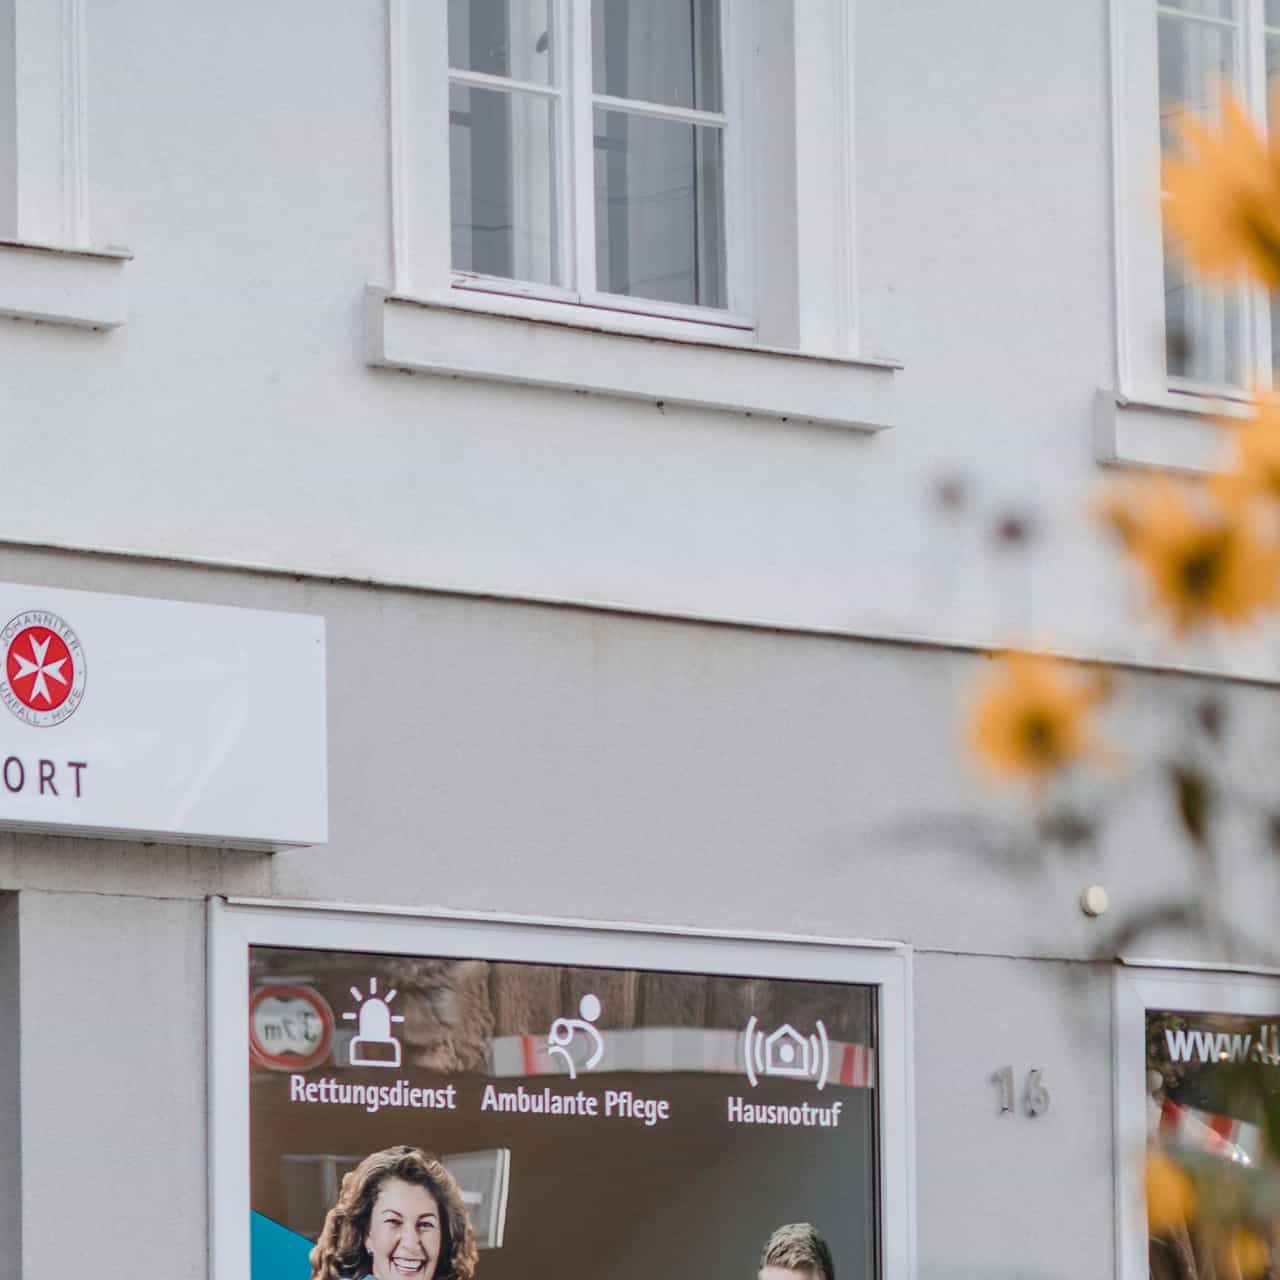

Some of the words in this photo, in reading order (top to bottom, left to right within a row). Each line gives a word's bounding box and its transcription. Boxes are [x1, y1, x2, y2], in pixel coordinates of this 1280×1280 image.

[3, 755, 88, 798] ORT
[290, 1073, 457, 1112] Rettungsdienst
[480, 1087, 599, 1118] Ambulante
[604, 1091, 670, 1126] Pflege
[990, 1064, 1051, 1118] 16
[727, 1096, 843, 1128] Hausnotruf
